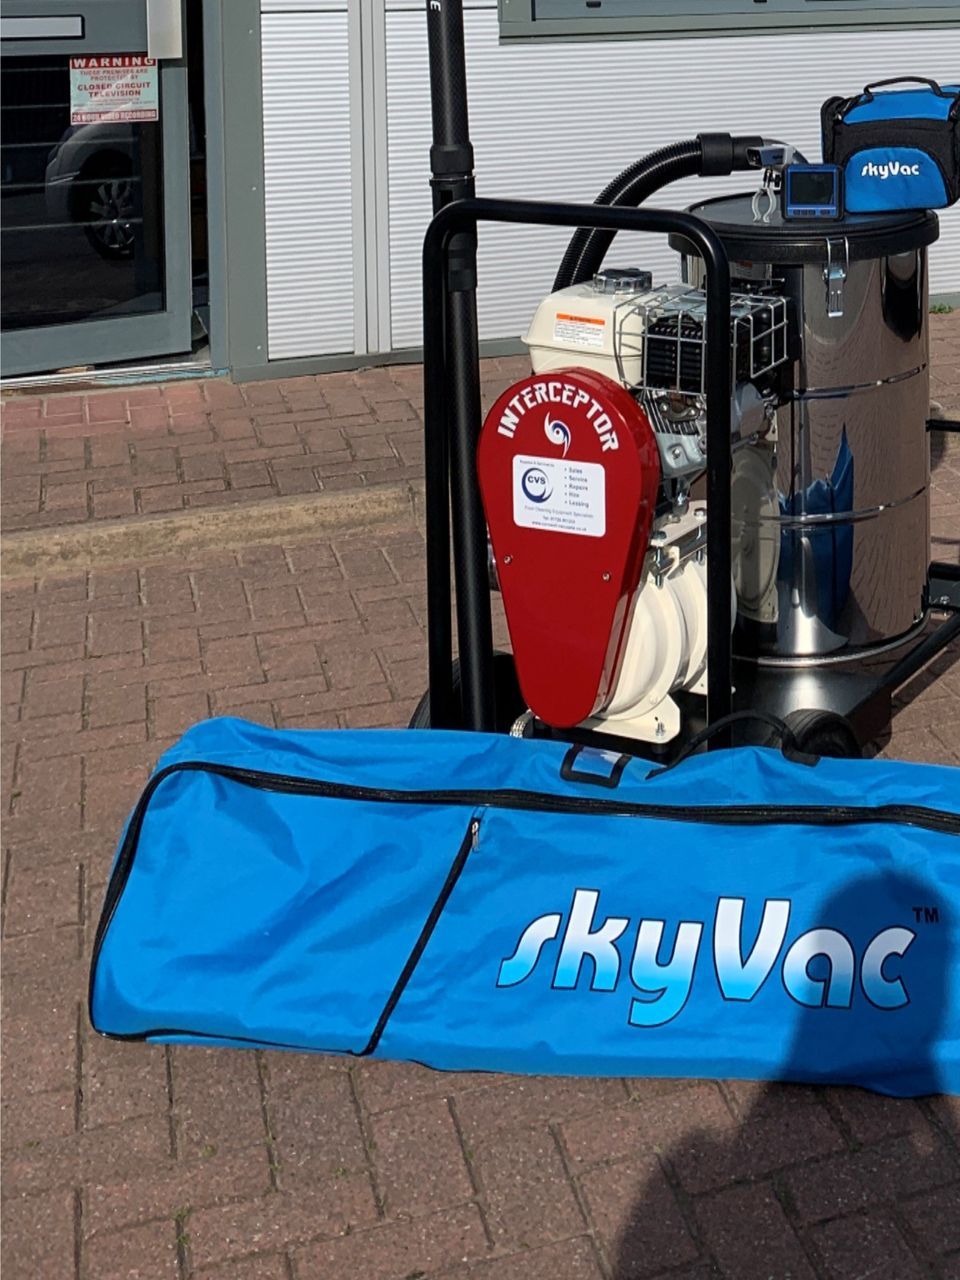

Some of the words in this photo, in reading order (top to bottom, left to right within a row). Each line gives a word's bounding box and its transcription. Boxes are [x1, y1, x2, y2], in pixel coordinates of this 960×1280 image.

[73, 56, 154, 68] WARNING
[77, 83, 112, 91] CLOSED
[861, 161, 920, 179] skyVac
[497, 382, 619, 452] INTERCEPTOR
[527, 475, 546, 485] CVS
[496, 887, 917, 1028] skyVac
